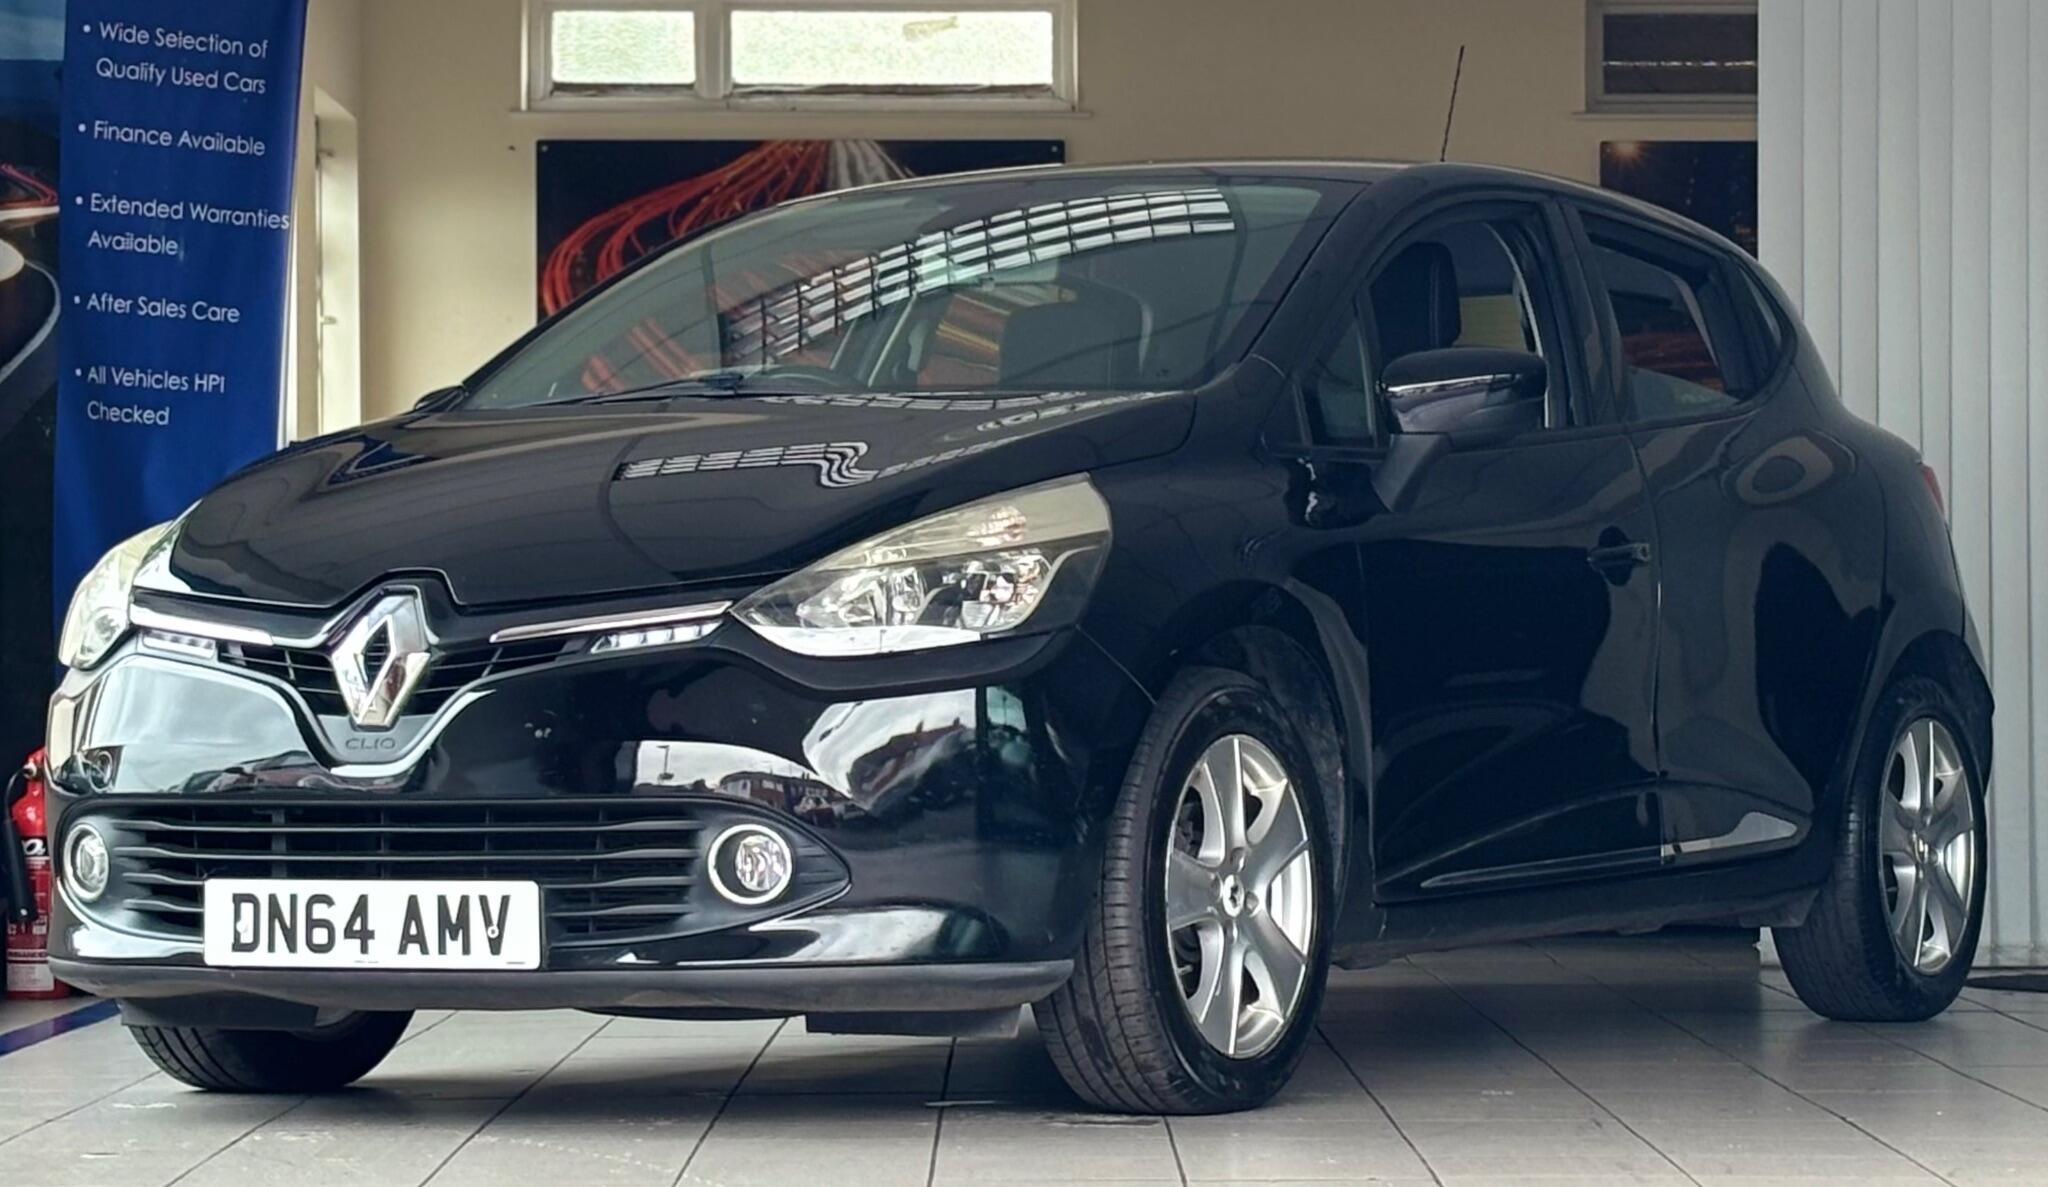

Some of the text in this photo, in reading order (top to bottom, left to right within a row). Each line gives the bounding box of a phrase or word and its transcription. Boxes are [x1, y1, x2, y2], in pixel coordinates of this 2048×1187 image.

[100, 22, 269, 58] Wide Selection of
[96, 58, 266, 95] Quality Used Cars
[94, 120, 265, 156] Finance Available
[91, 193, 290, 230] Extended Warranties
[88, 230, 179, 255] Available
[87, 293, 240, 323] After Sales Care
[87, 365, 225, 393] All Vehicles HPI
[87, 401, 170, 425] Checked
[345, 737, 396, 750] CLIO
[231, 893, 511, 956] DN64 AMV
